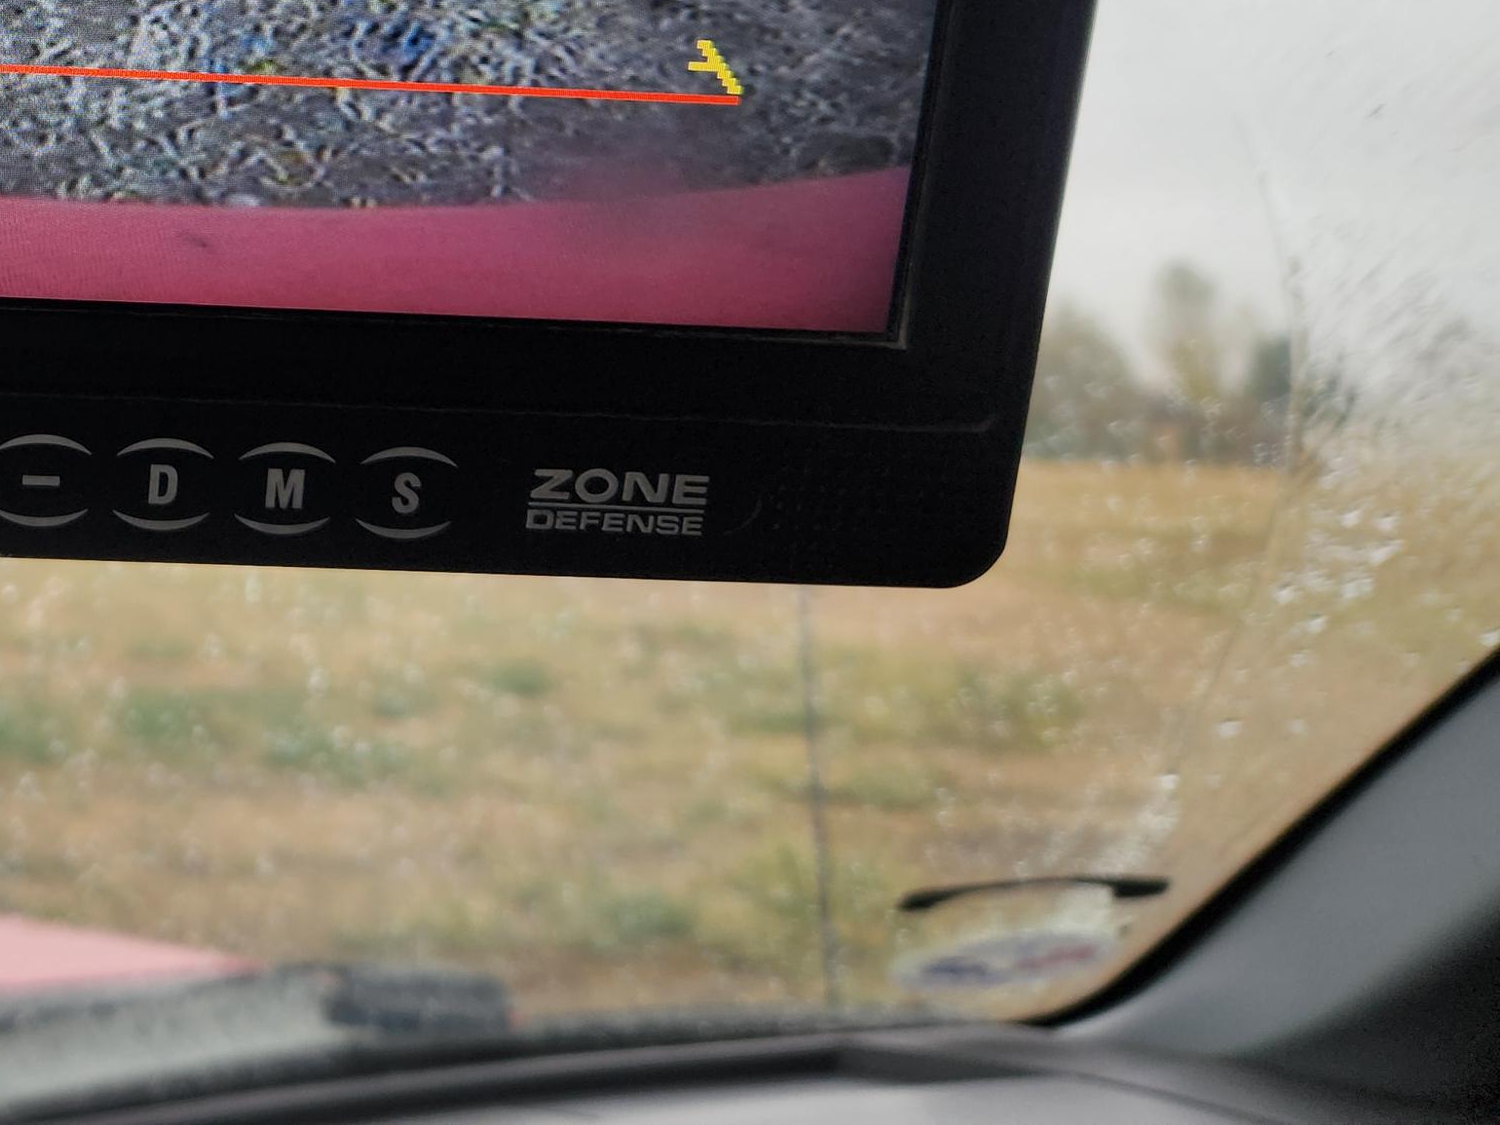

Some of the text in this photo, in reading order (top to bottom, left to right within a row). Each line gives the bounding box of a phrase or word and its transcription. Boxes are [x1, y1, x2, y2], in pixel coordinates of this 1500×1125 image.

[148, 464, 178, 505] D
[265, 468, 305, 509] M
[392, 472, 421, 514] S
[530, 468, 710, 506] ZONE
[525, 509, 704, 536] DEFENSE
